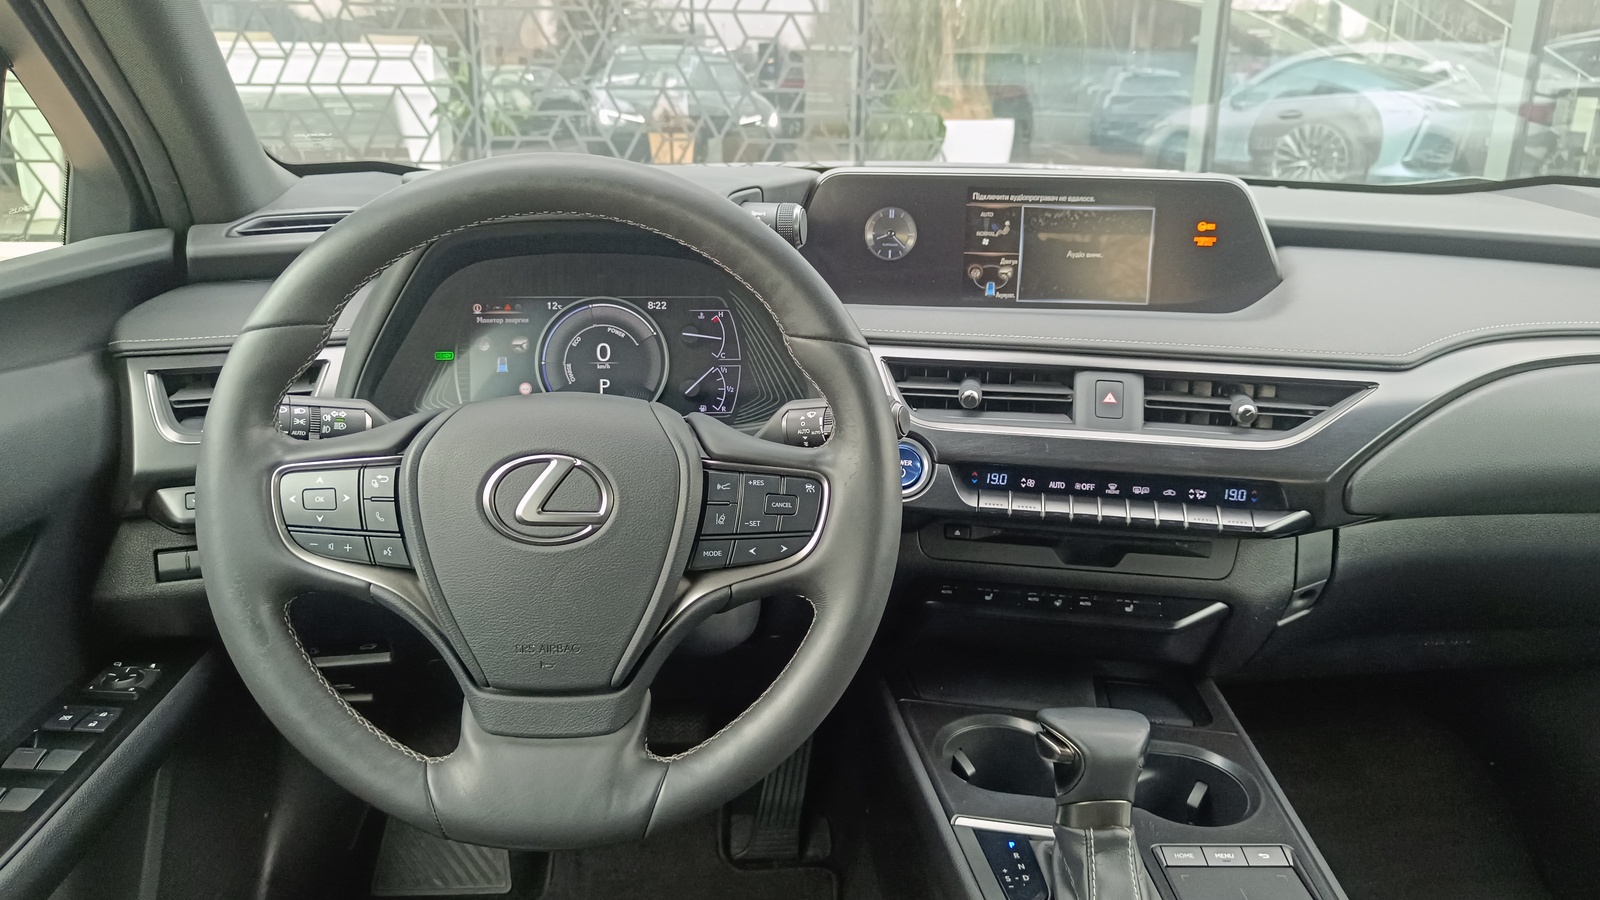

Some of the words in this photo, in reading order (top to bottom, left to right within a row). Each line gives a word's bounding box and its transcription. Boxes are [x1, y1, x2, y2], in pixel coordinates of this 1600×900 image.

[1066, 250, 1085, 259] Аудіо
[647, 301, 667, 310] 8:22
[607, 327, 626, 339] POWER
[571, 336, 582, 347] ECO
[596, 343, 611, 362] 0
[599, 378, 611, 395] P
[986, 473, 1008, 486] 19.0
[1048, 481, 1066, 489] AUTO
[1081, 483, 1095, 491] OFF
[1224, 489, 1247, 502] 19.0
[539, 643, 581, 655] AIRBAG
[1008, 841, 1015, 849] P
